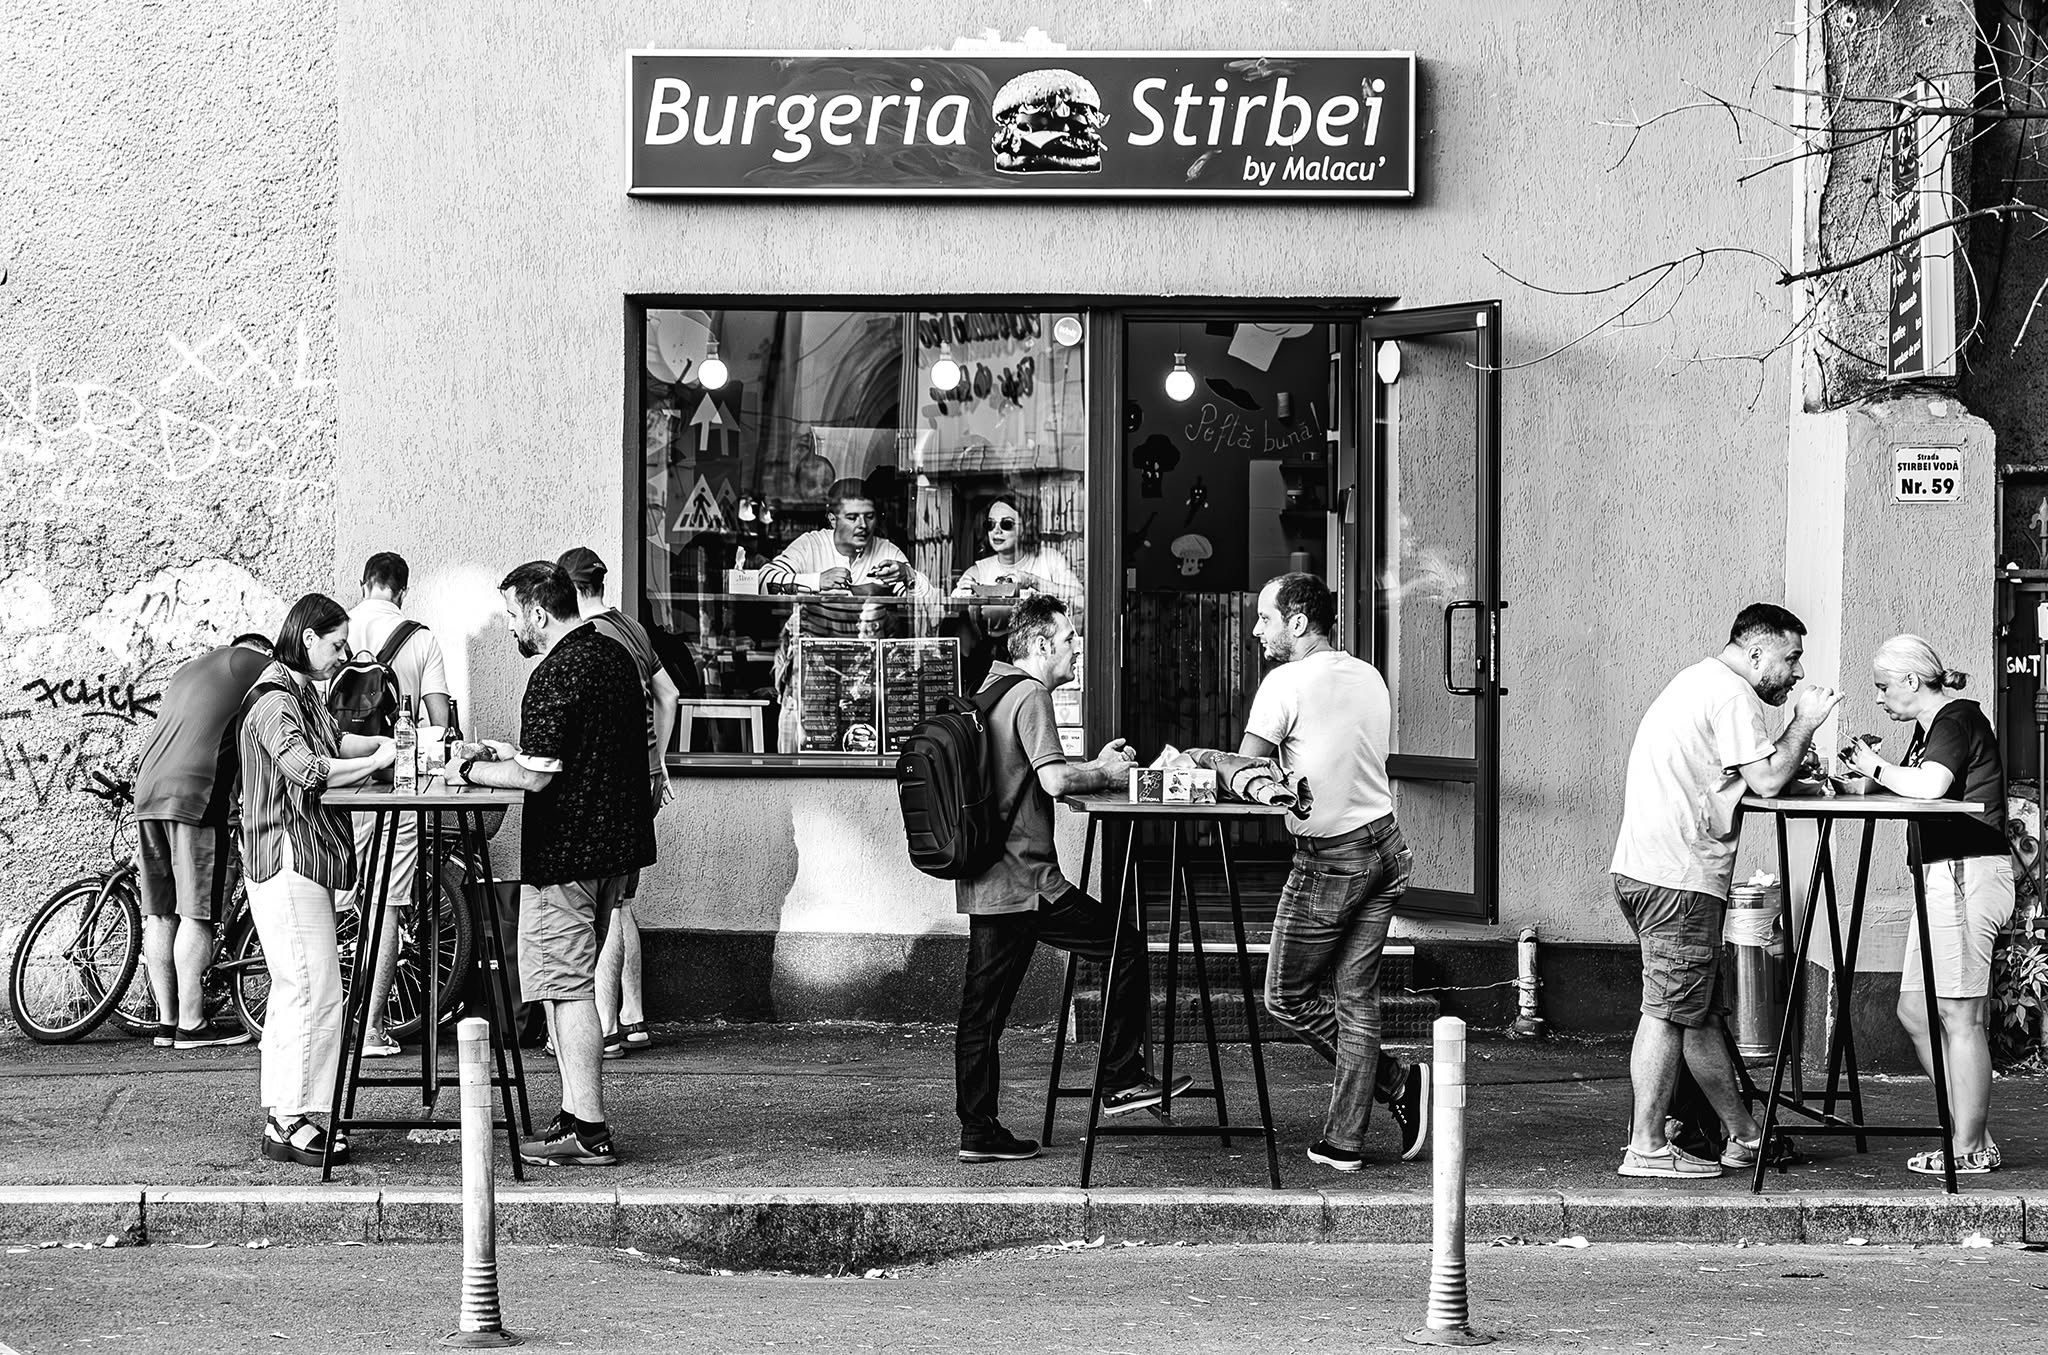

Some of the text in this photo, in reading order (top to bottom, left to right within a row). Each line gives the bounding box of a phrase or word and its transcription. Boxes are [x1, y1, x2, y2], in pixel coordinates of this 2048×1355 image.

[643, 75, 1387, 163] Burgeria Stirbei
[1242, 154, 1278, 186] by
[1917, 453, 1940, 461] Strada
[1932, 459, 1959, 471] VODĂ
[1901, 478, 1955, 494] Nr. 59
